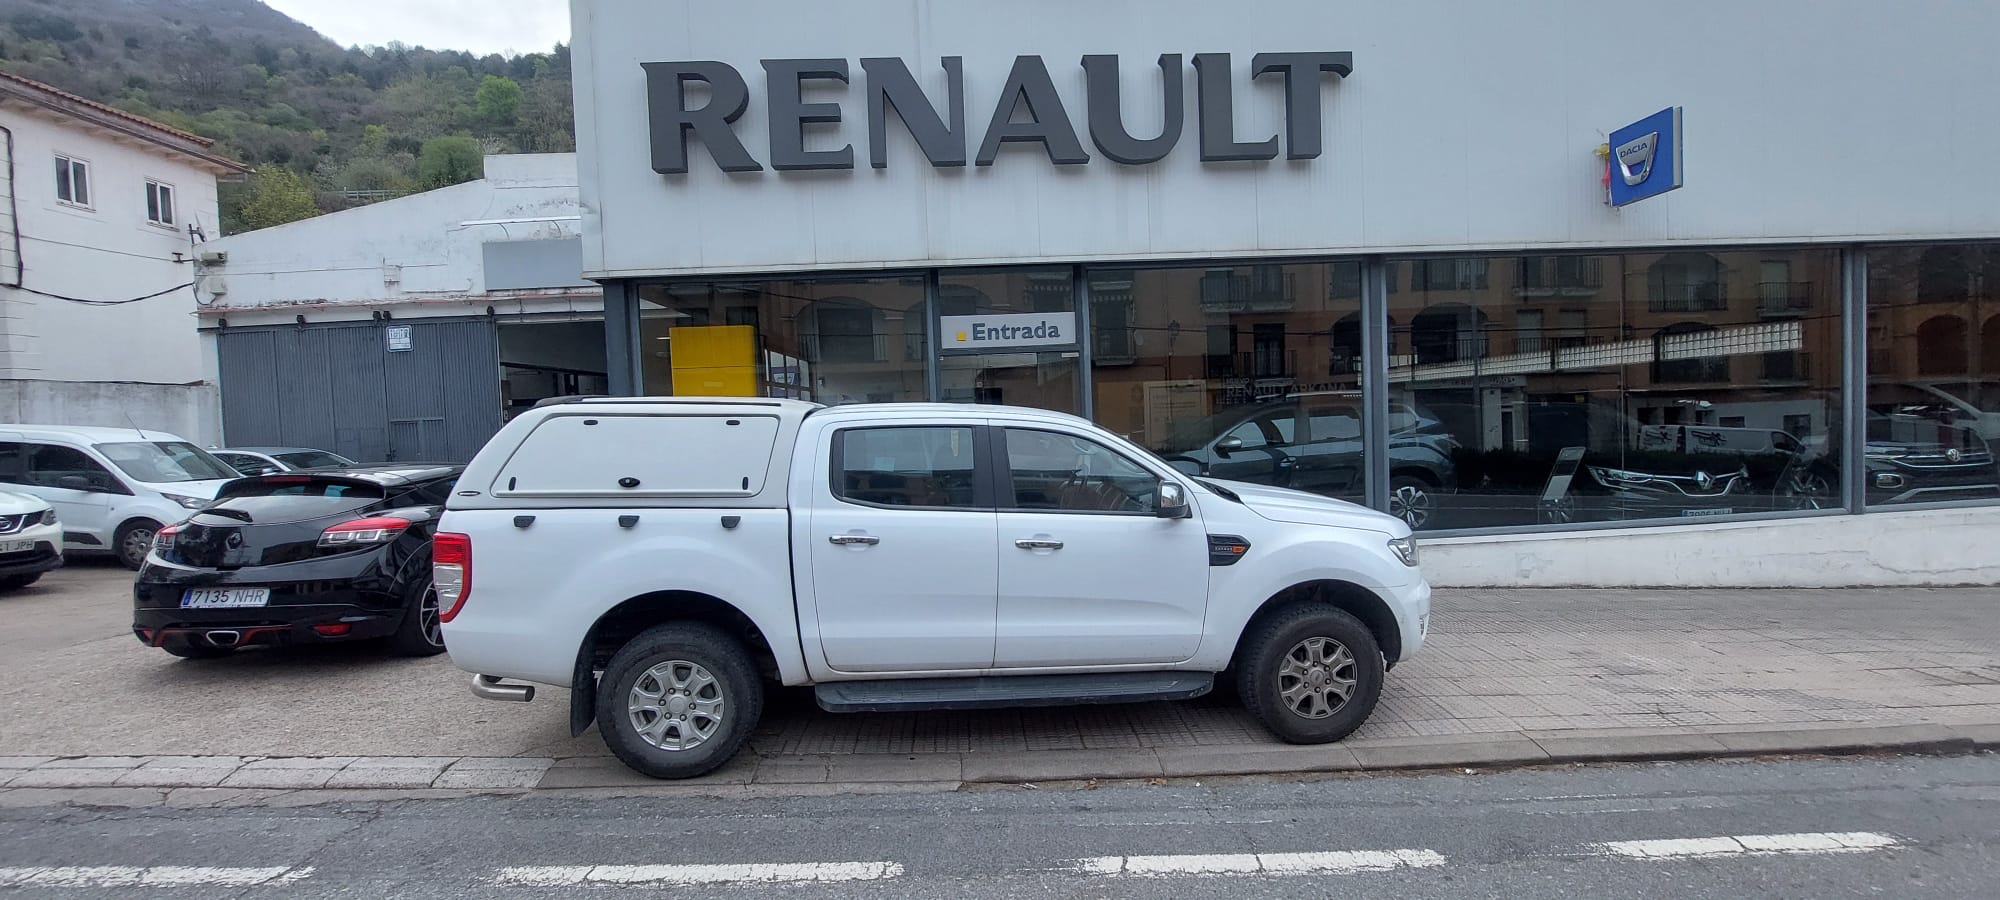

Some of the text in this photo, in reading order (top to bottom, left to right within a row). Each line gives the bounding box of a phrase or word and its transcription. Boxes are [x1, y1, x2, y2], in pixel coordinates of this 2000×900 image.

[640, 51, 1353, 174] RENAULT
[1620, 142, 1648, 158] DACIA
[972, 321, 1060, 341] Entrada
[1226, 382, 1347, 398] RENAULT ARKANA
[193, 589, 265, 604] 7135 NHR
